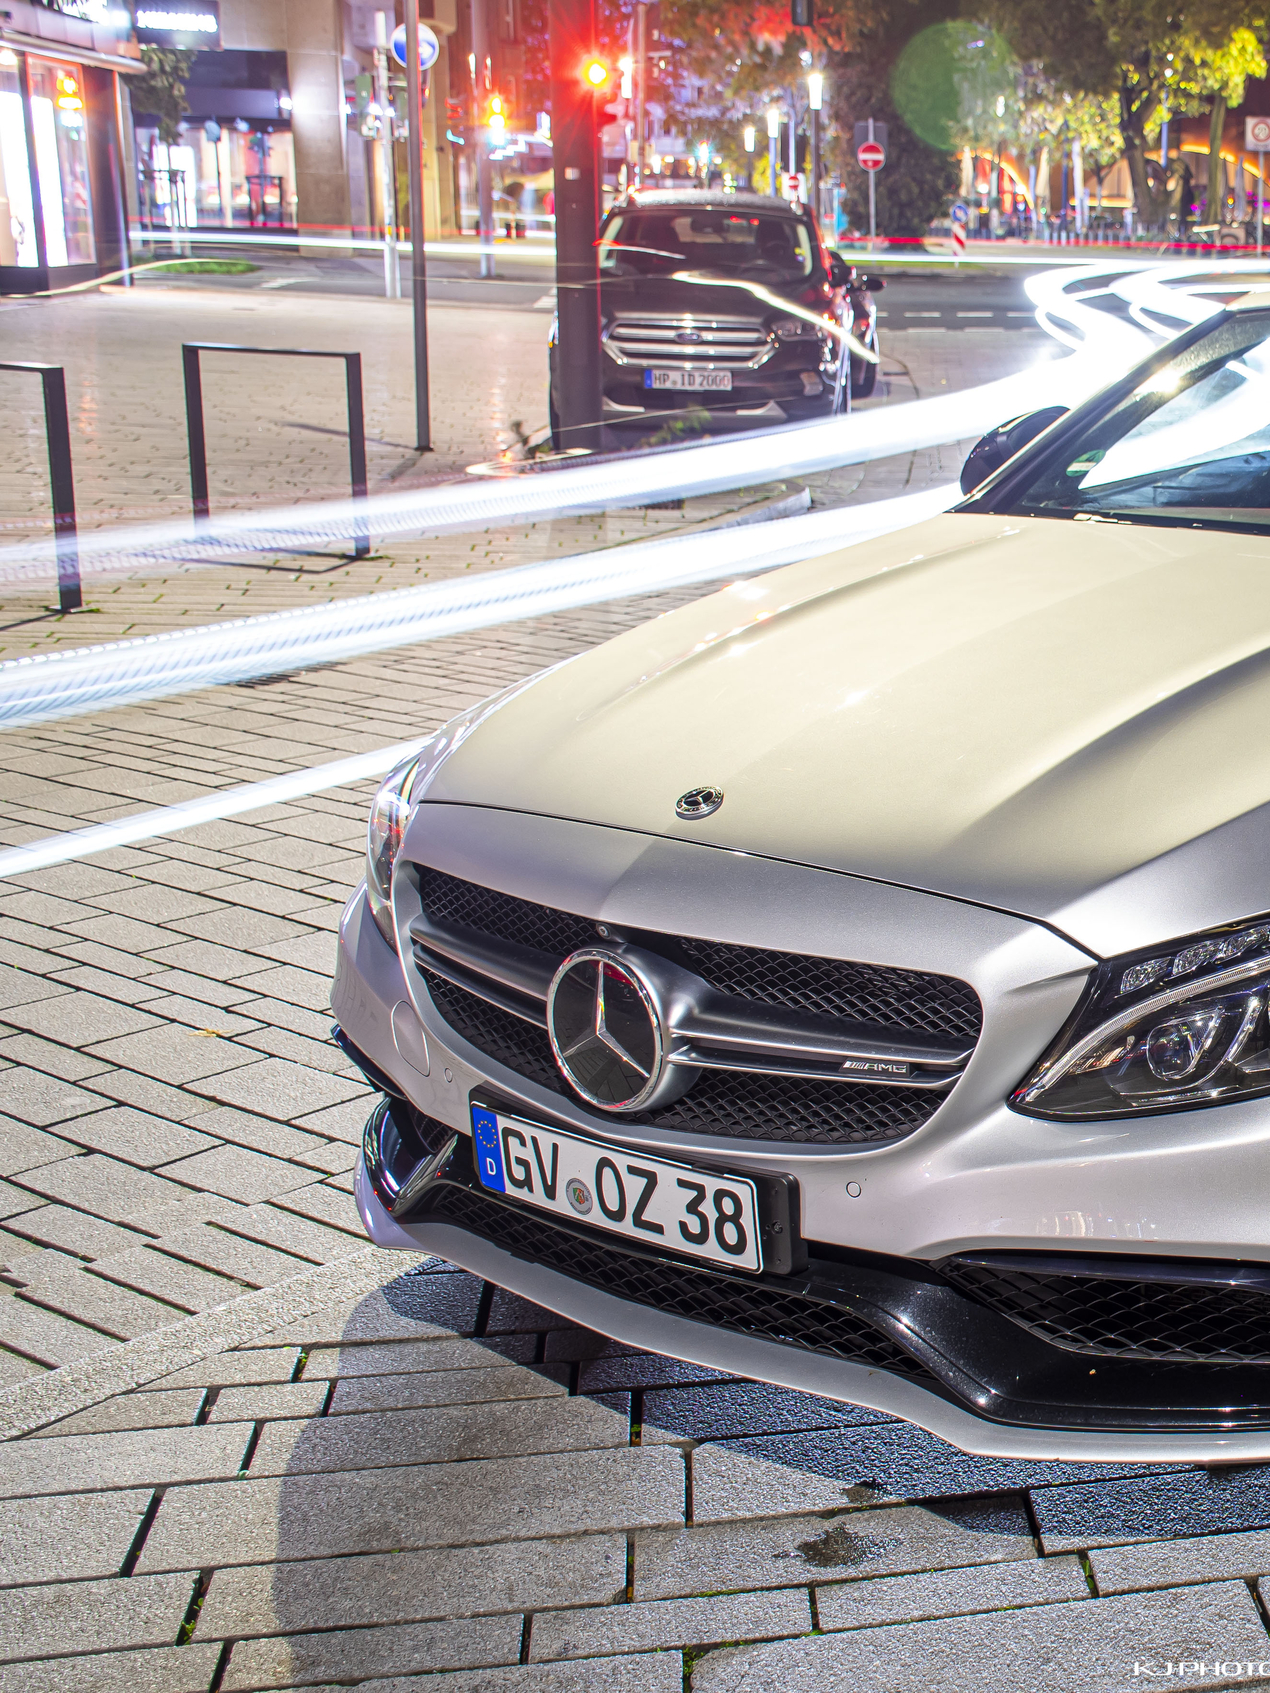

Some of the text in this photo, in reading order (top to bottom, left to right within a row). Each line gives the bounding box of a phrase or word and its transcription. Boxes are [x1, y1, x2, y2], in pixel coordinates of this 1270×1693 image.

[654, 373, 670, 386] HP
[864, 1063, 907, 1073] AMG
[486, 1157, 498, 1176] D
[501, 1126, 559, 1201] GV
[594, 1156, 665, 1235] OZ
[676, 1177, 748, 1256] 38
